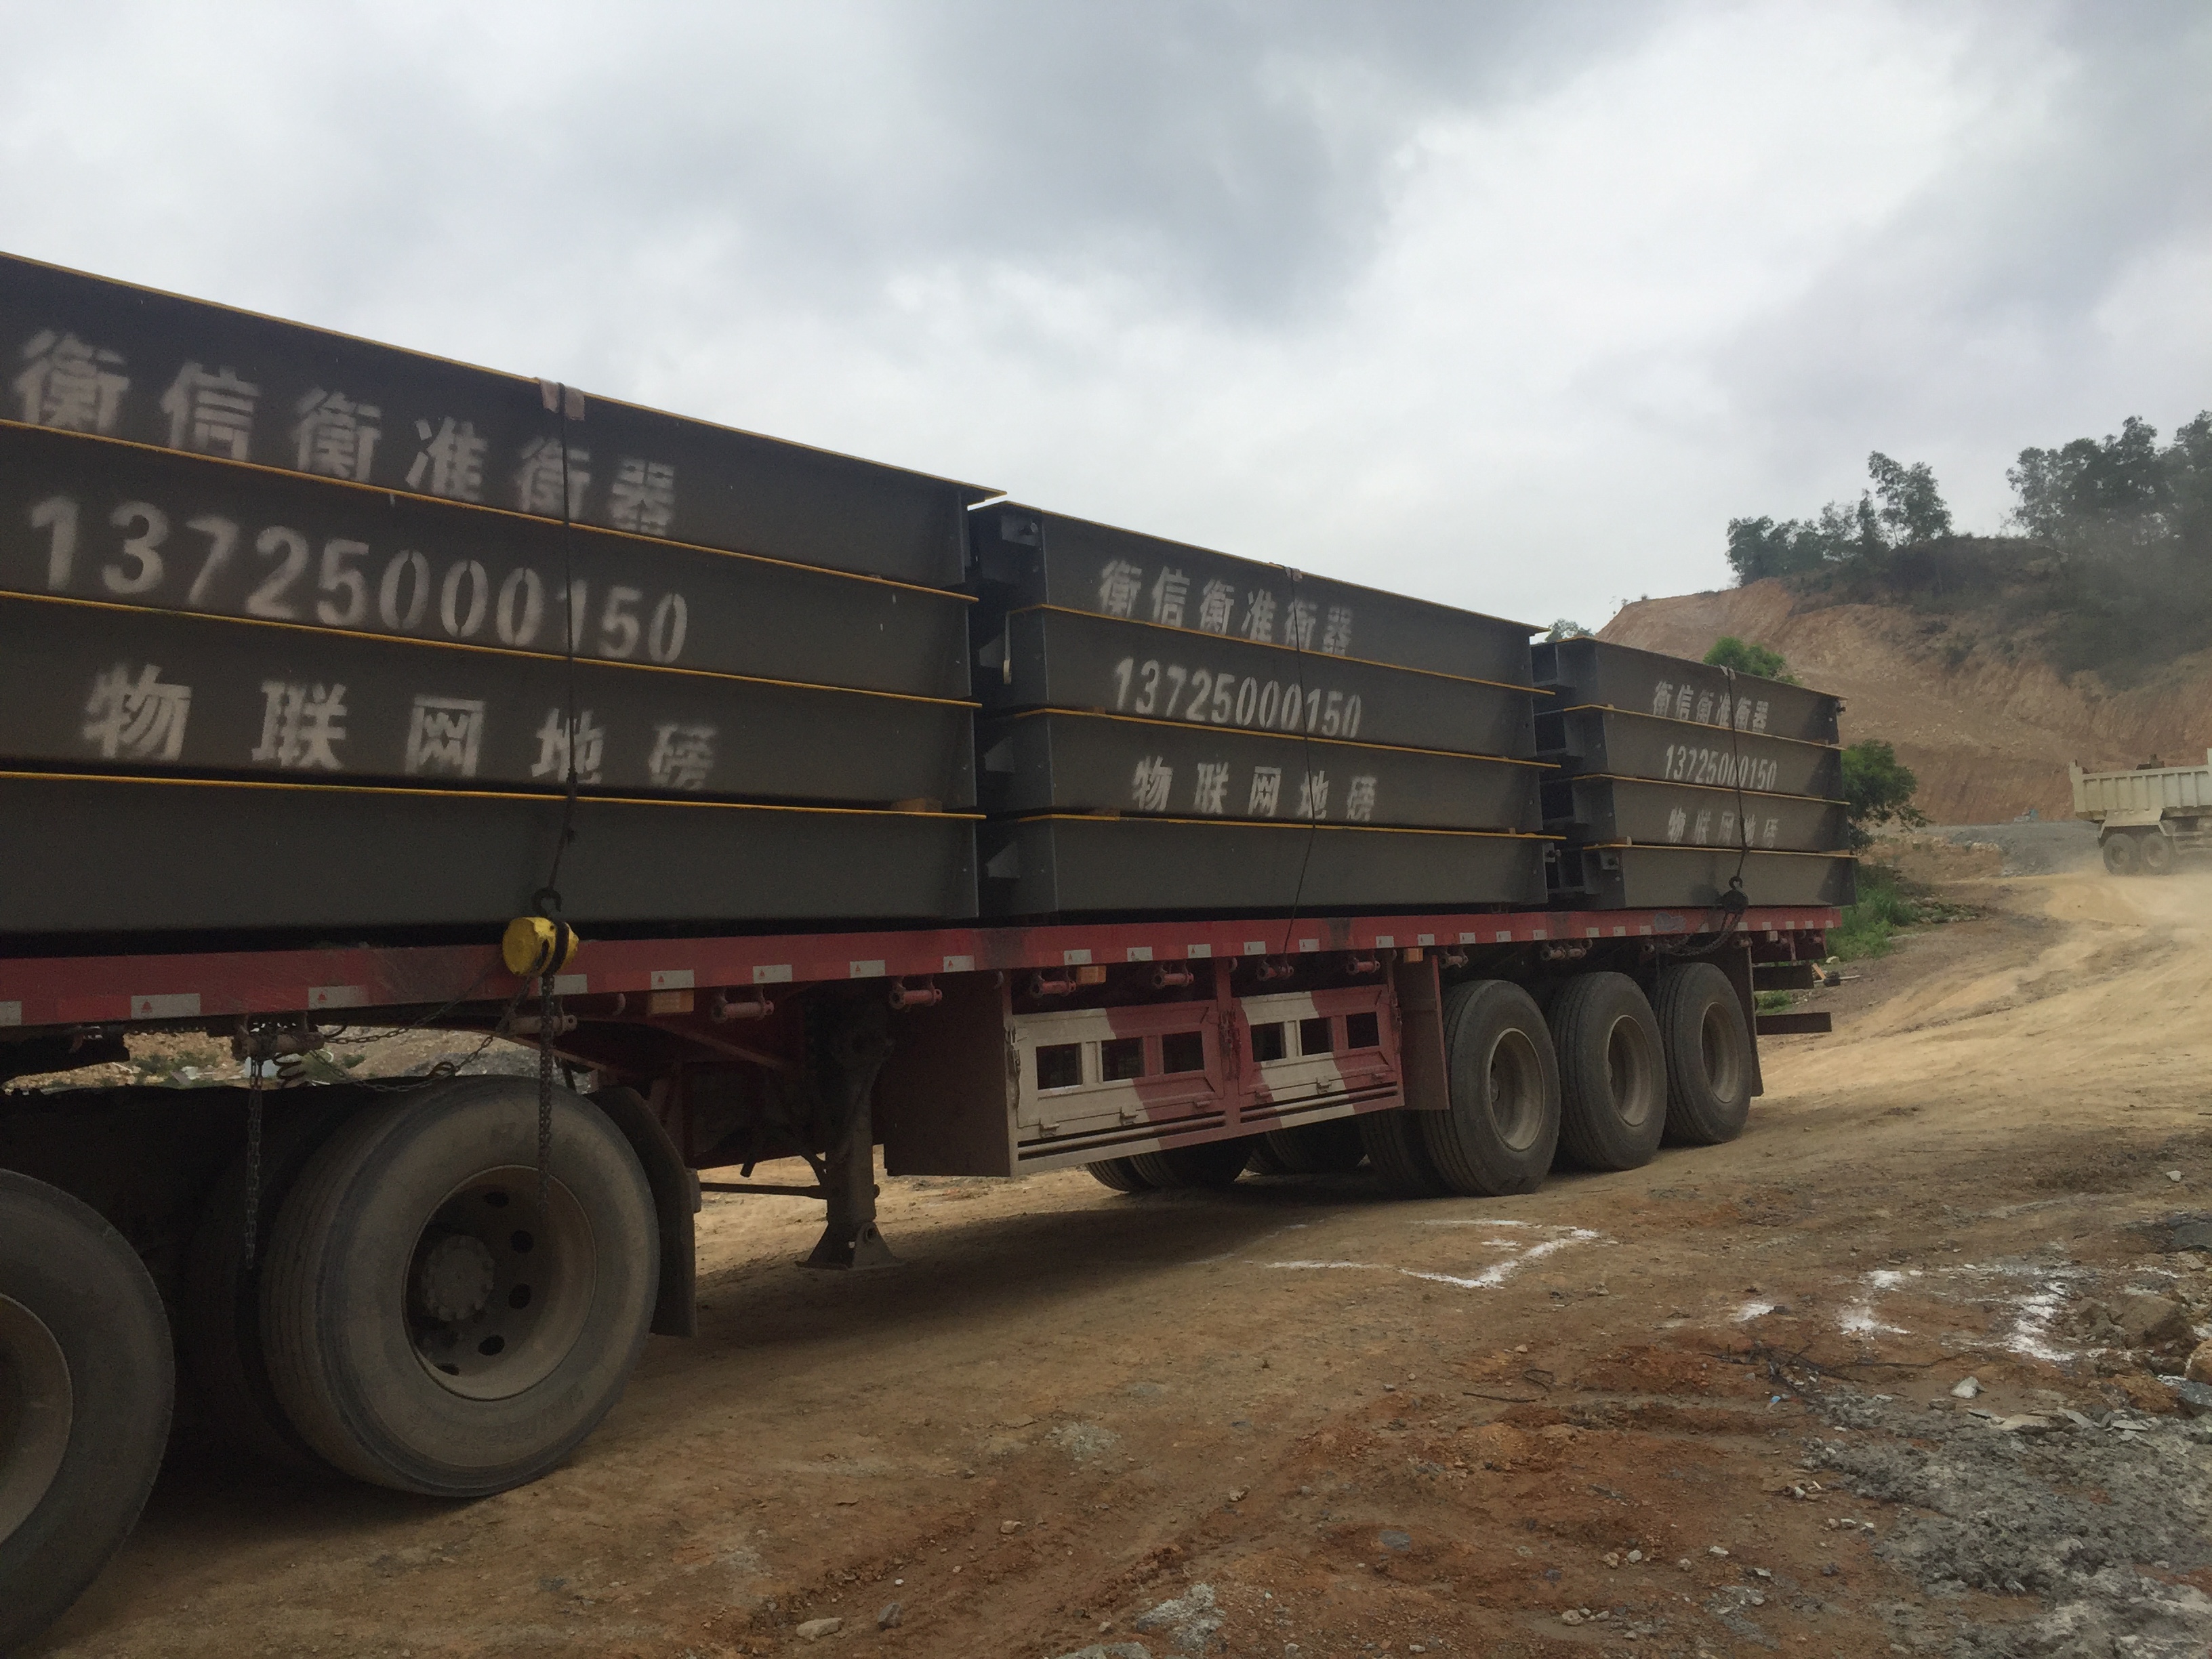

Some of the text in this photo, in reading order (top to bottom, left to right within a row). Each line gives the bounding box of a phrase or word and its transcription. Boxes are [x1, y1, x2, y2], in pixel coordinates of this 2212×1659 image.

[29, 495, 688, 663] 13725000150
[83, 663, 717, 791] 物联网地磅
[1115, 657, 1362, 739] 13725000150
[1664, 744, 1777, 790] 13725000150
